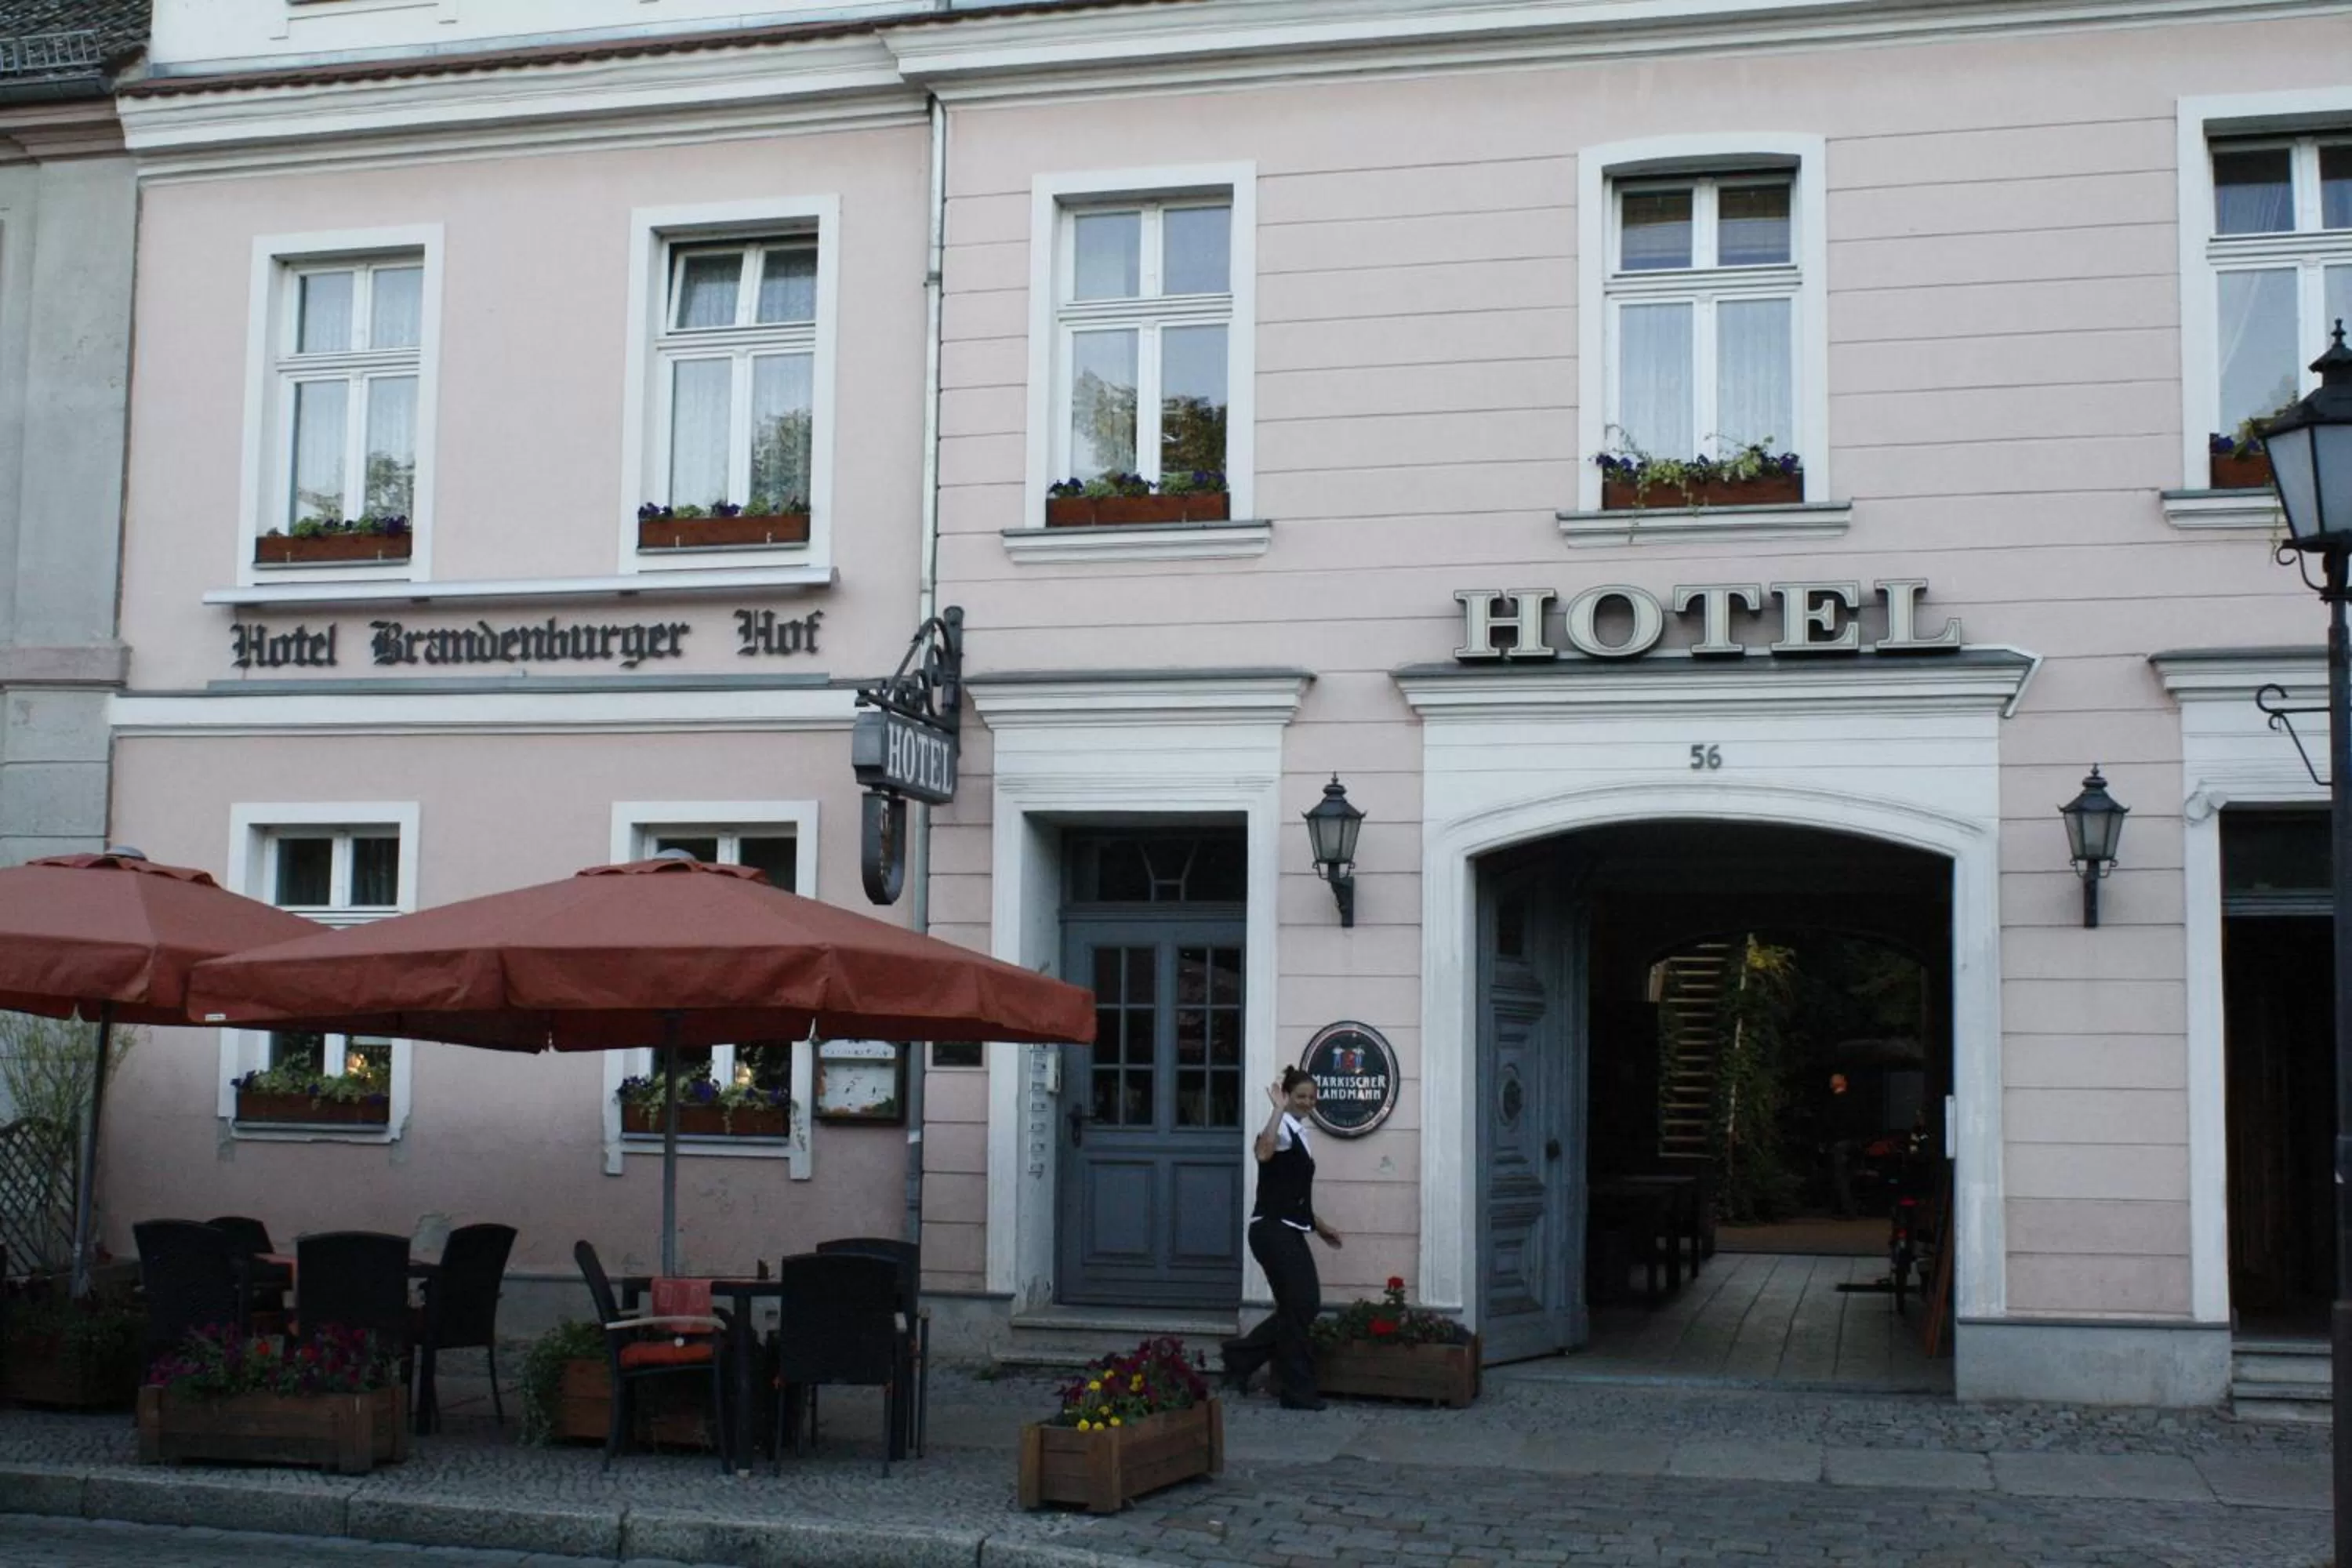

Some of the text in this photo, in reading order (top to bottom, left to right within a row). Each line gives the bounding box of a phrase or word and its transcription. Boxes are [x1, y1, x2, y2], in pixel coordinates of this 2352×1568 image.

[230, 609, 825, 668] Hotel Brandenburger Hof
[1454, 579, 1961, 662] HOTEL
[887, 723, 953, 794] HOTEL
[1690, 744, 1722, 770] 56
